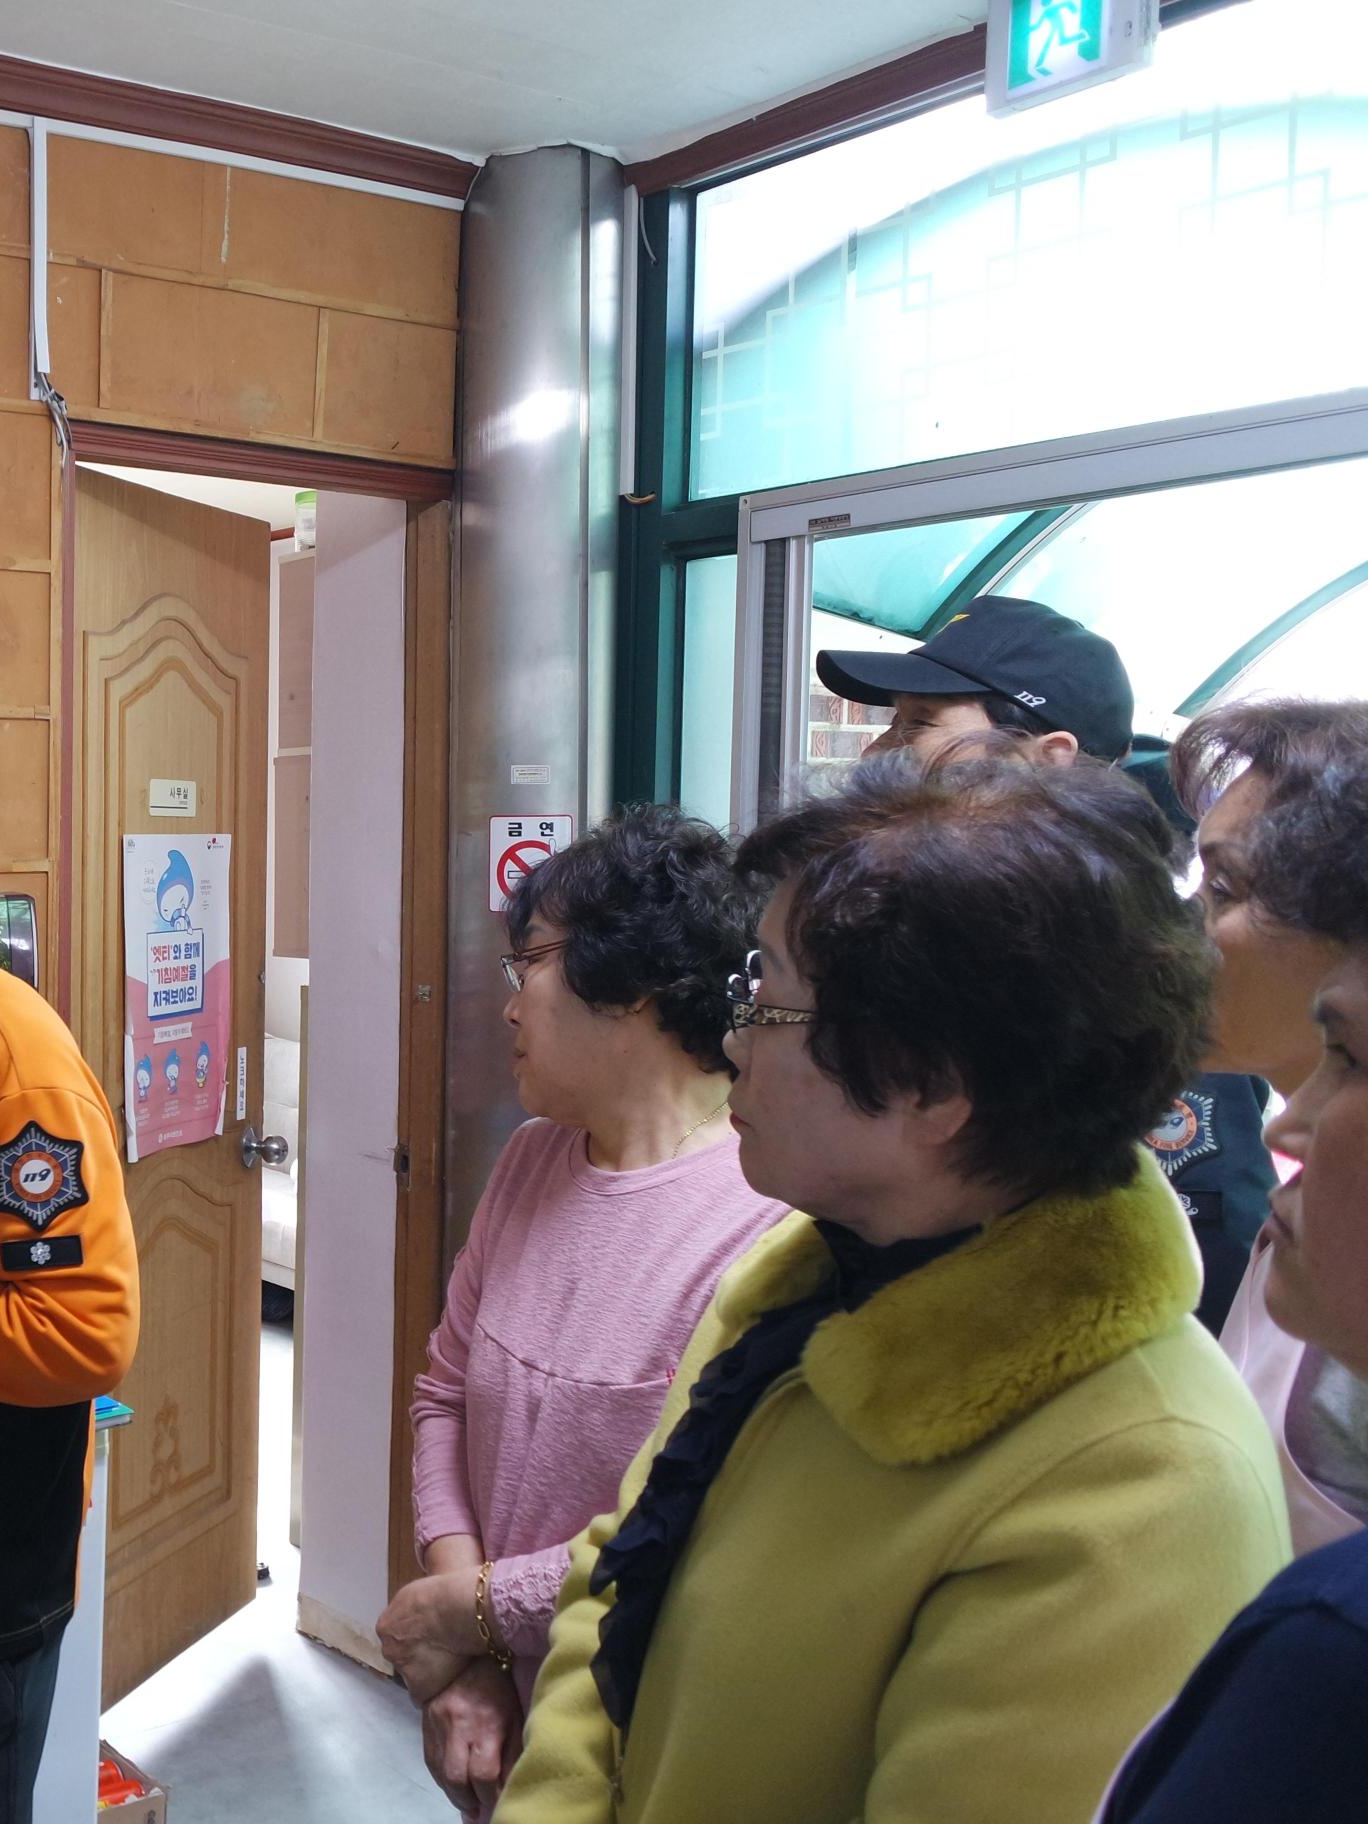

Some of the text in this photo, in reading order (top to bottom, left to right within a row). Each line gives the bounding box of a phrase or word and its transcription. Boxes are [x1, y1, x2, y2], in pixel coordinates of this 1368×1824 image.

[1013, 690, 1047, 708] 119
[170, 787, 189, 800] 사무실
[184, 942, 201, 960] 함께
[22, 1168, 51, 1183] 119
